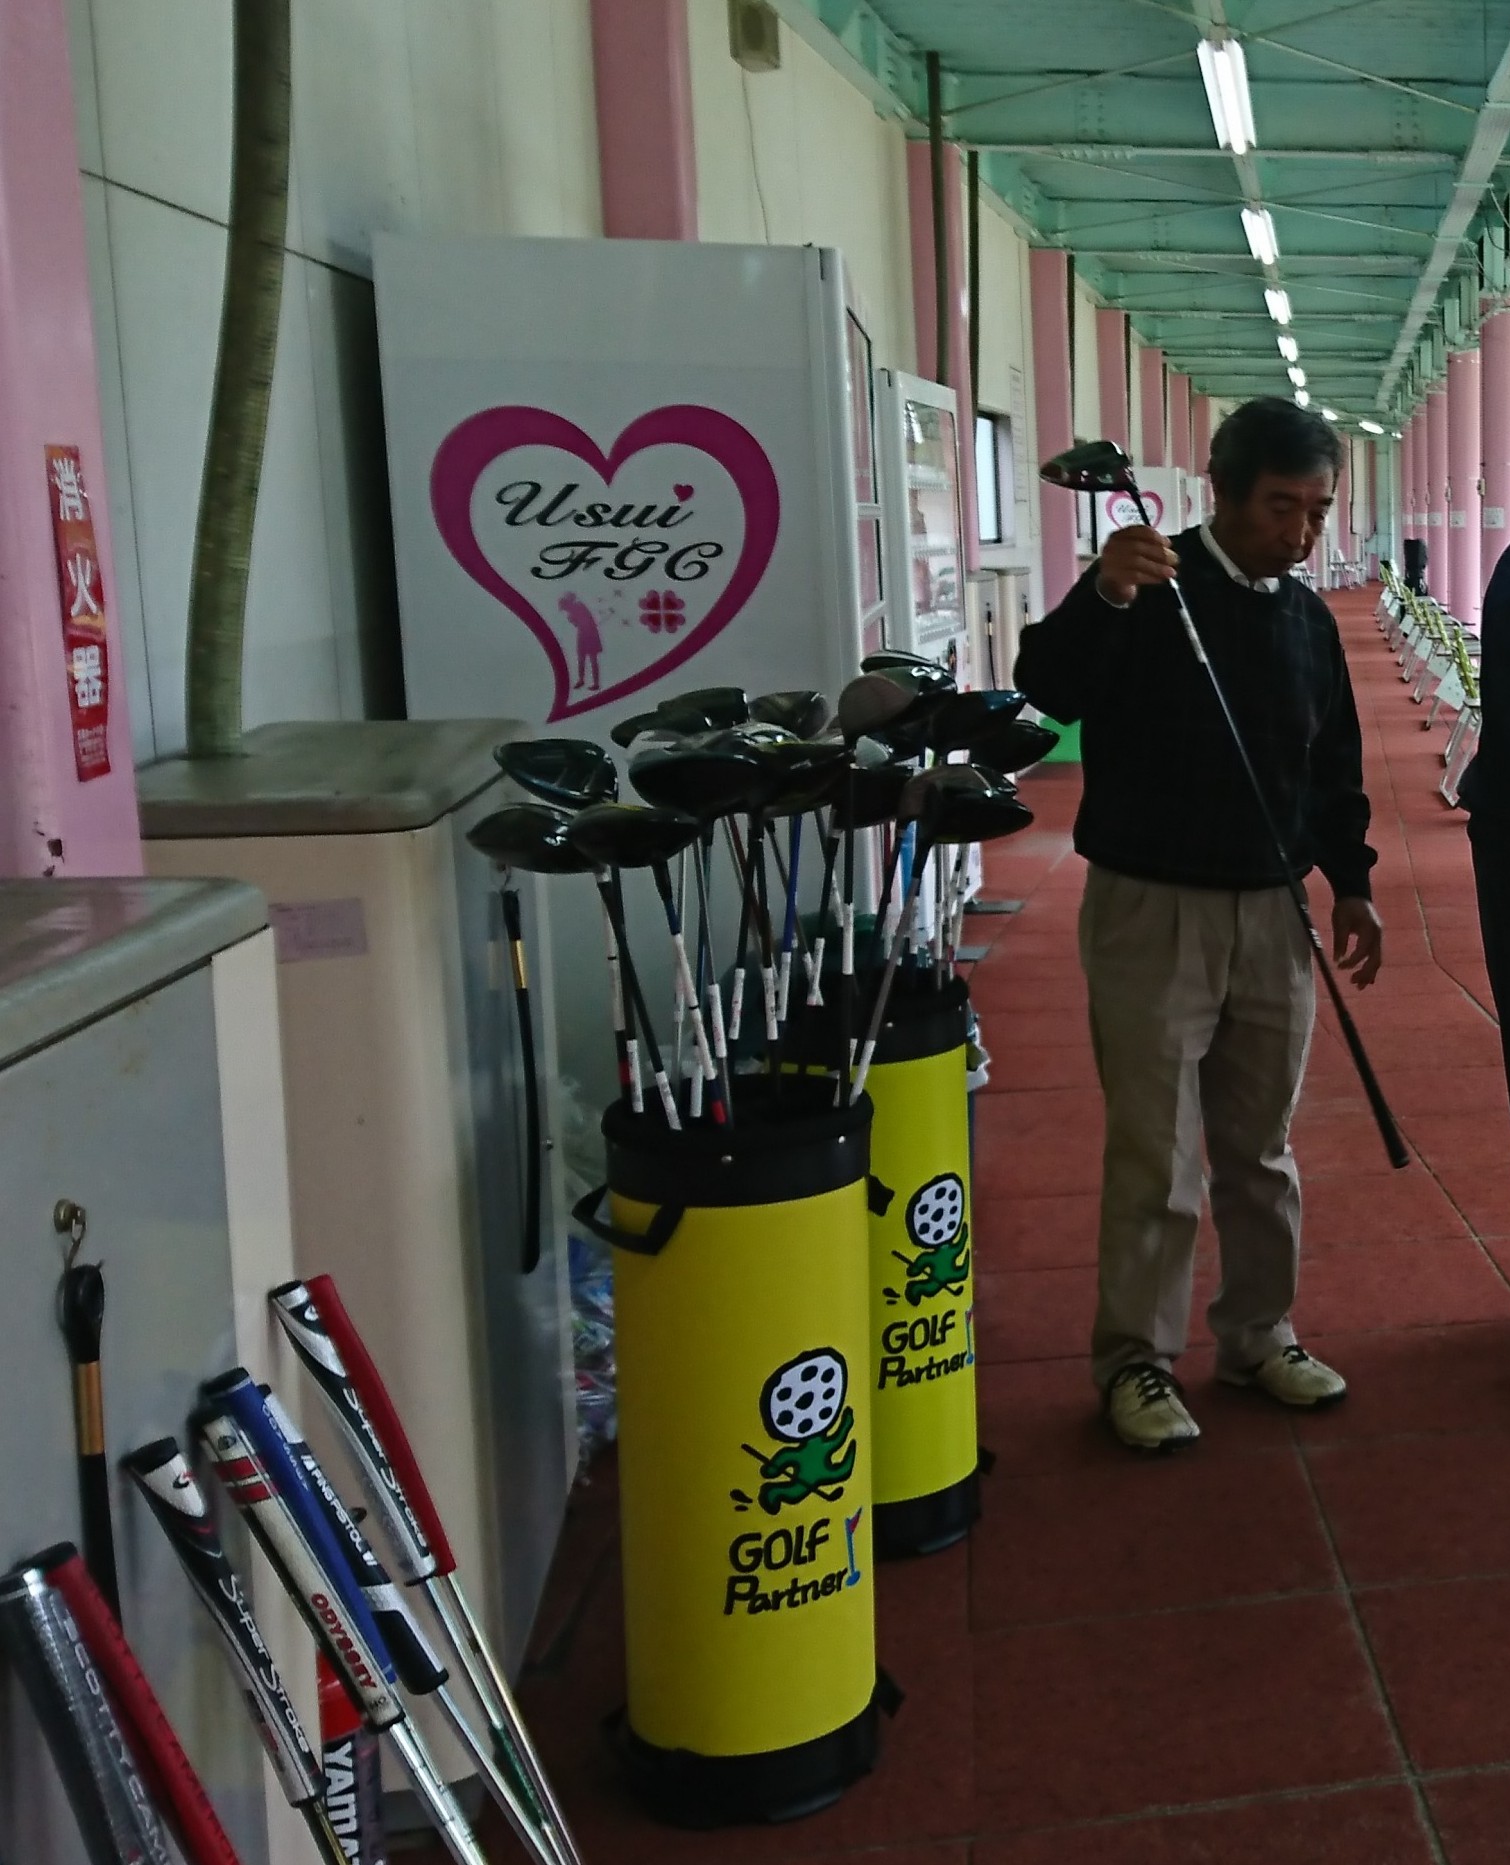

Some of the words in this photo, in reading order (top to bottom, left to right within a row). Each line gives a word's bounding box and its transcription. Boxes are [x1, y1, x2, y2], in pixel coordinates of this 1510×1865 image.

[495, 480, 694, 528] Usui
[530, 537, 724, 581] FGC
[881, 1309, 957, 1355] GOLF
[877, 1350, 968, 1390] Partner
[728, 1518, 831, 1574] GOLF
[723, 1567, 848, 1616] Partner
[311, 1593, 378, 1689] ODYSSEY
